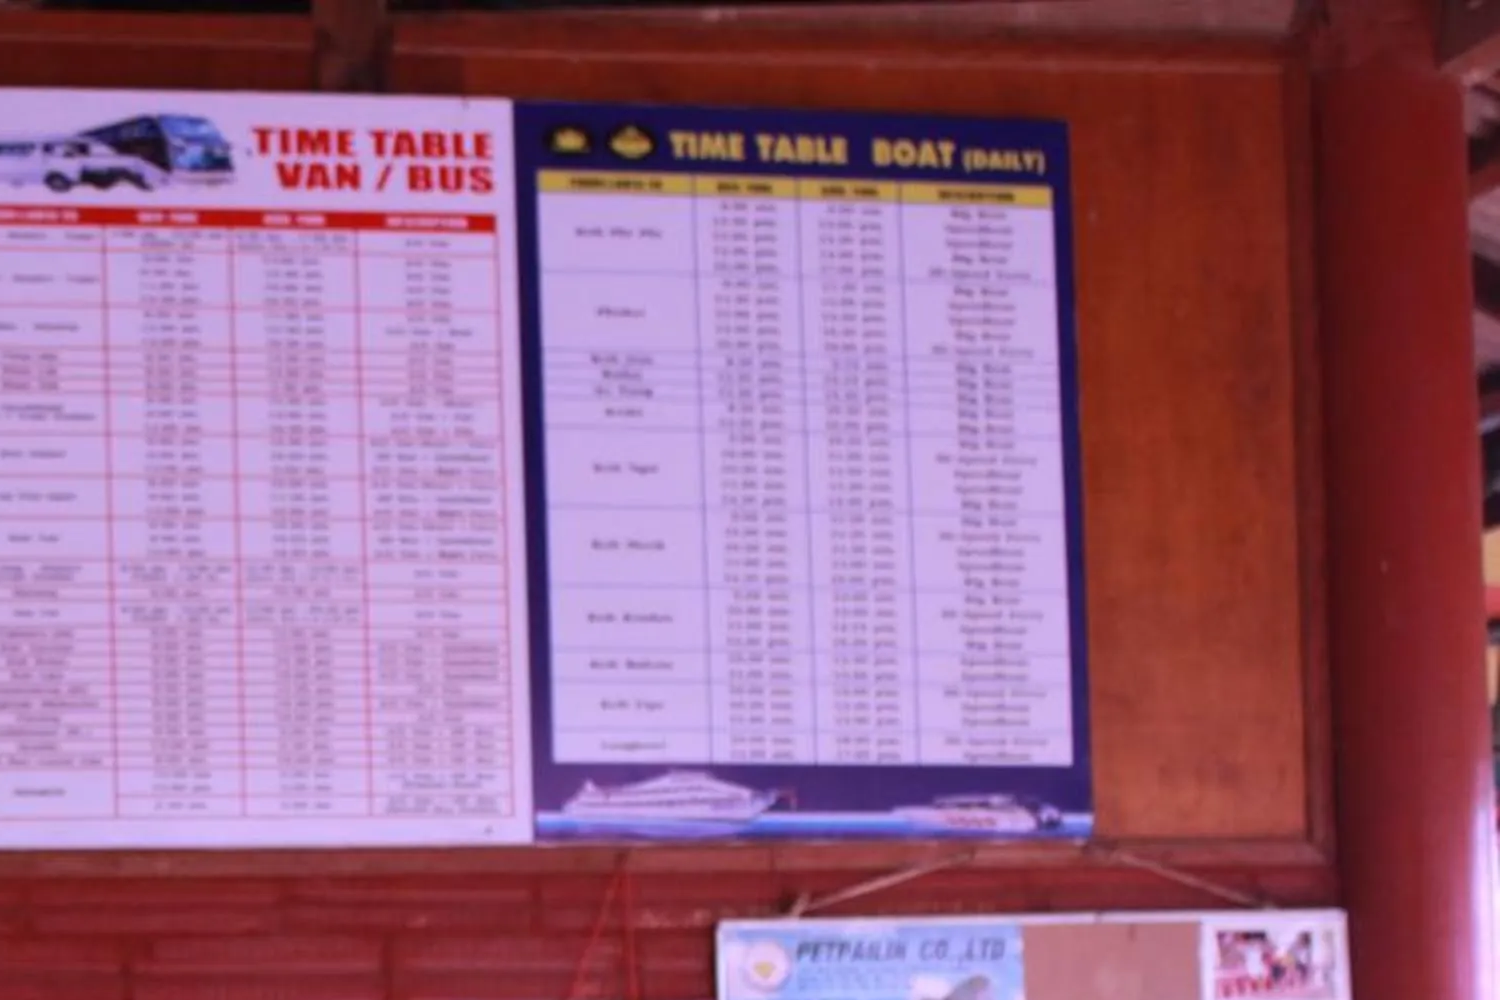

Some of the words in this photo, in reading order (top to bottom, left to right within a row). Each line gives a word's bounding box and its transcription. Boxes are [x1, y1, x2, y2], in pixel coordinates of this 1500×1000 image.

[251, 126, 356, 159] TIME
[367, 129, 495, 161] TABLE
[667, 130, 746, 161] TIME
[756, 133, 849, 165] TABLE
[872, 137, 957, 170] BOAT
[962, 144, 1047, 175] (DAILY)
[275, 161, 363, 191] VAN
[407, 164, 495, 194] BUS
